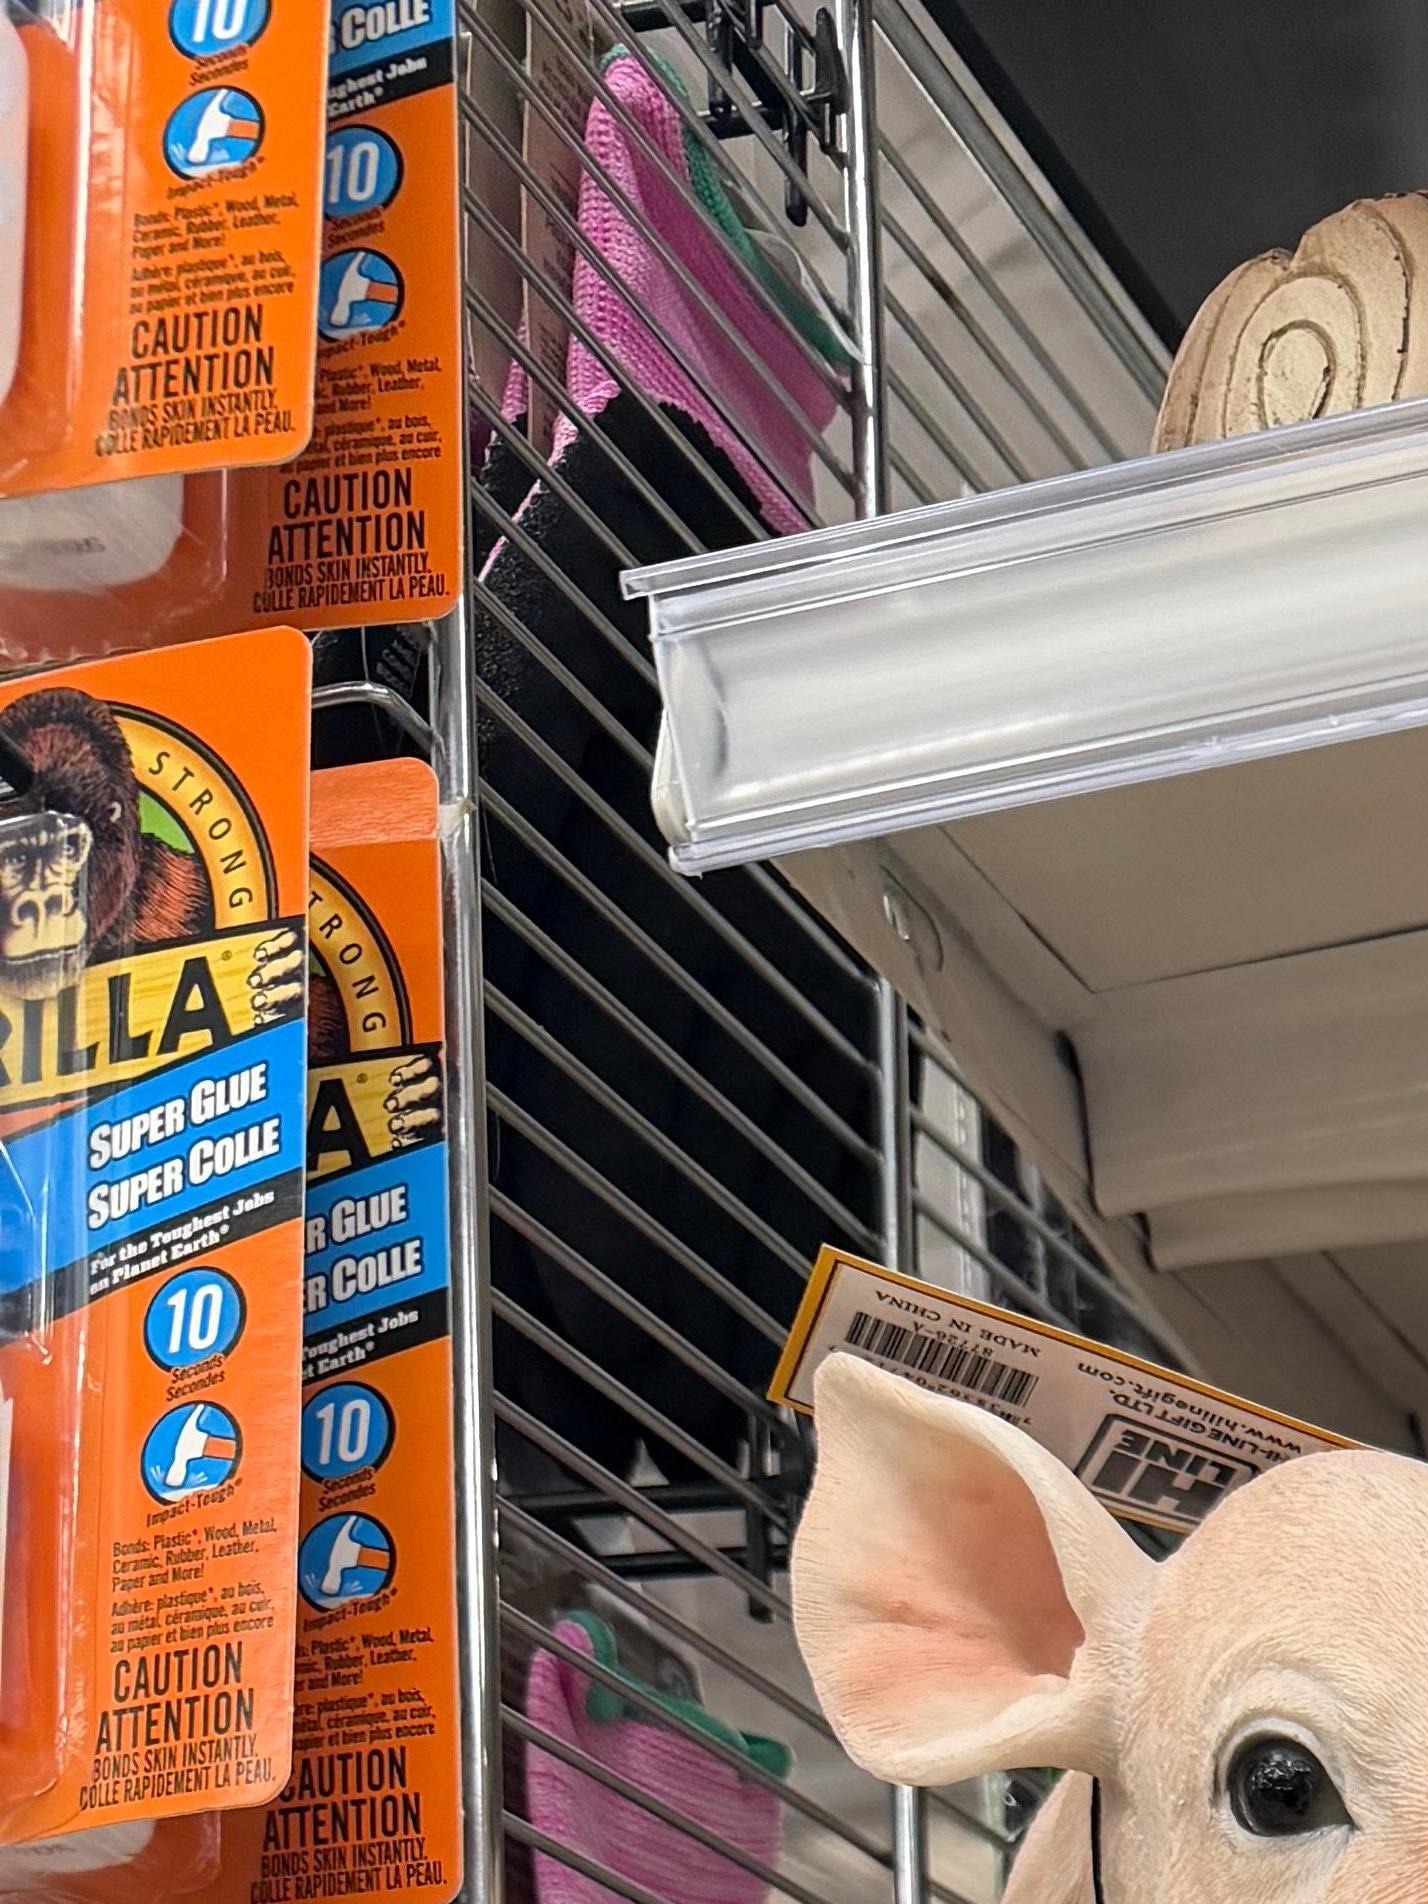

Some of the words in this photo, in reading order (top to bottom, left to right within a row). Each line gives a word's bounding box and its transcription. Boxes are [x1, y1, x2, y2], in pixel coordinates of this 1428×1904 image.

[341, 0, 430, 47] COLLE
[327, 141, 378, 203] 10
[132, 304, 263, 360] CAUTION
[112, 347, 274, 405] ATTENTION
[283, 468, 412, 519] CAUTION
[268, 510, 425, 565] ATTENTION
[149, 751, 253, 910] STRONG
[308, 892, 386, 1034] TRONG
[89, 1098, 184, 1170] SUPER
[189, 1063, 267, 1125] GLUE
[87, 1158, 183, 1230] SUPER
[188, 1120, 280, 1186] COLLE
[331, 1186, 407, 1241] GLUE
[333, 1239, 423, 1301] COLLE
[167, 1284, 223, 1354] 10
[875, 1290, 941, 1322] CHINA
[950, 1317, 972, 1333] IN
[980, 1328, 1042, 1358] MADE
[316, 1399, 369, 1466] 10
[1115, 1428, 1238, 1487] LINE
[113, 1641, 243, 1703] CAUTION
[95, 1688, 254, 1755] ATTENTION
[182, 1733, 258, 1767] INSTANTLY.
[124, 1766, 211, 1803] RAPIDEMENT
[235, 1758, 276, 1786] PEAU.
[263, 1792, 421, 1852] ATTENTION
